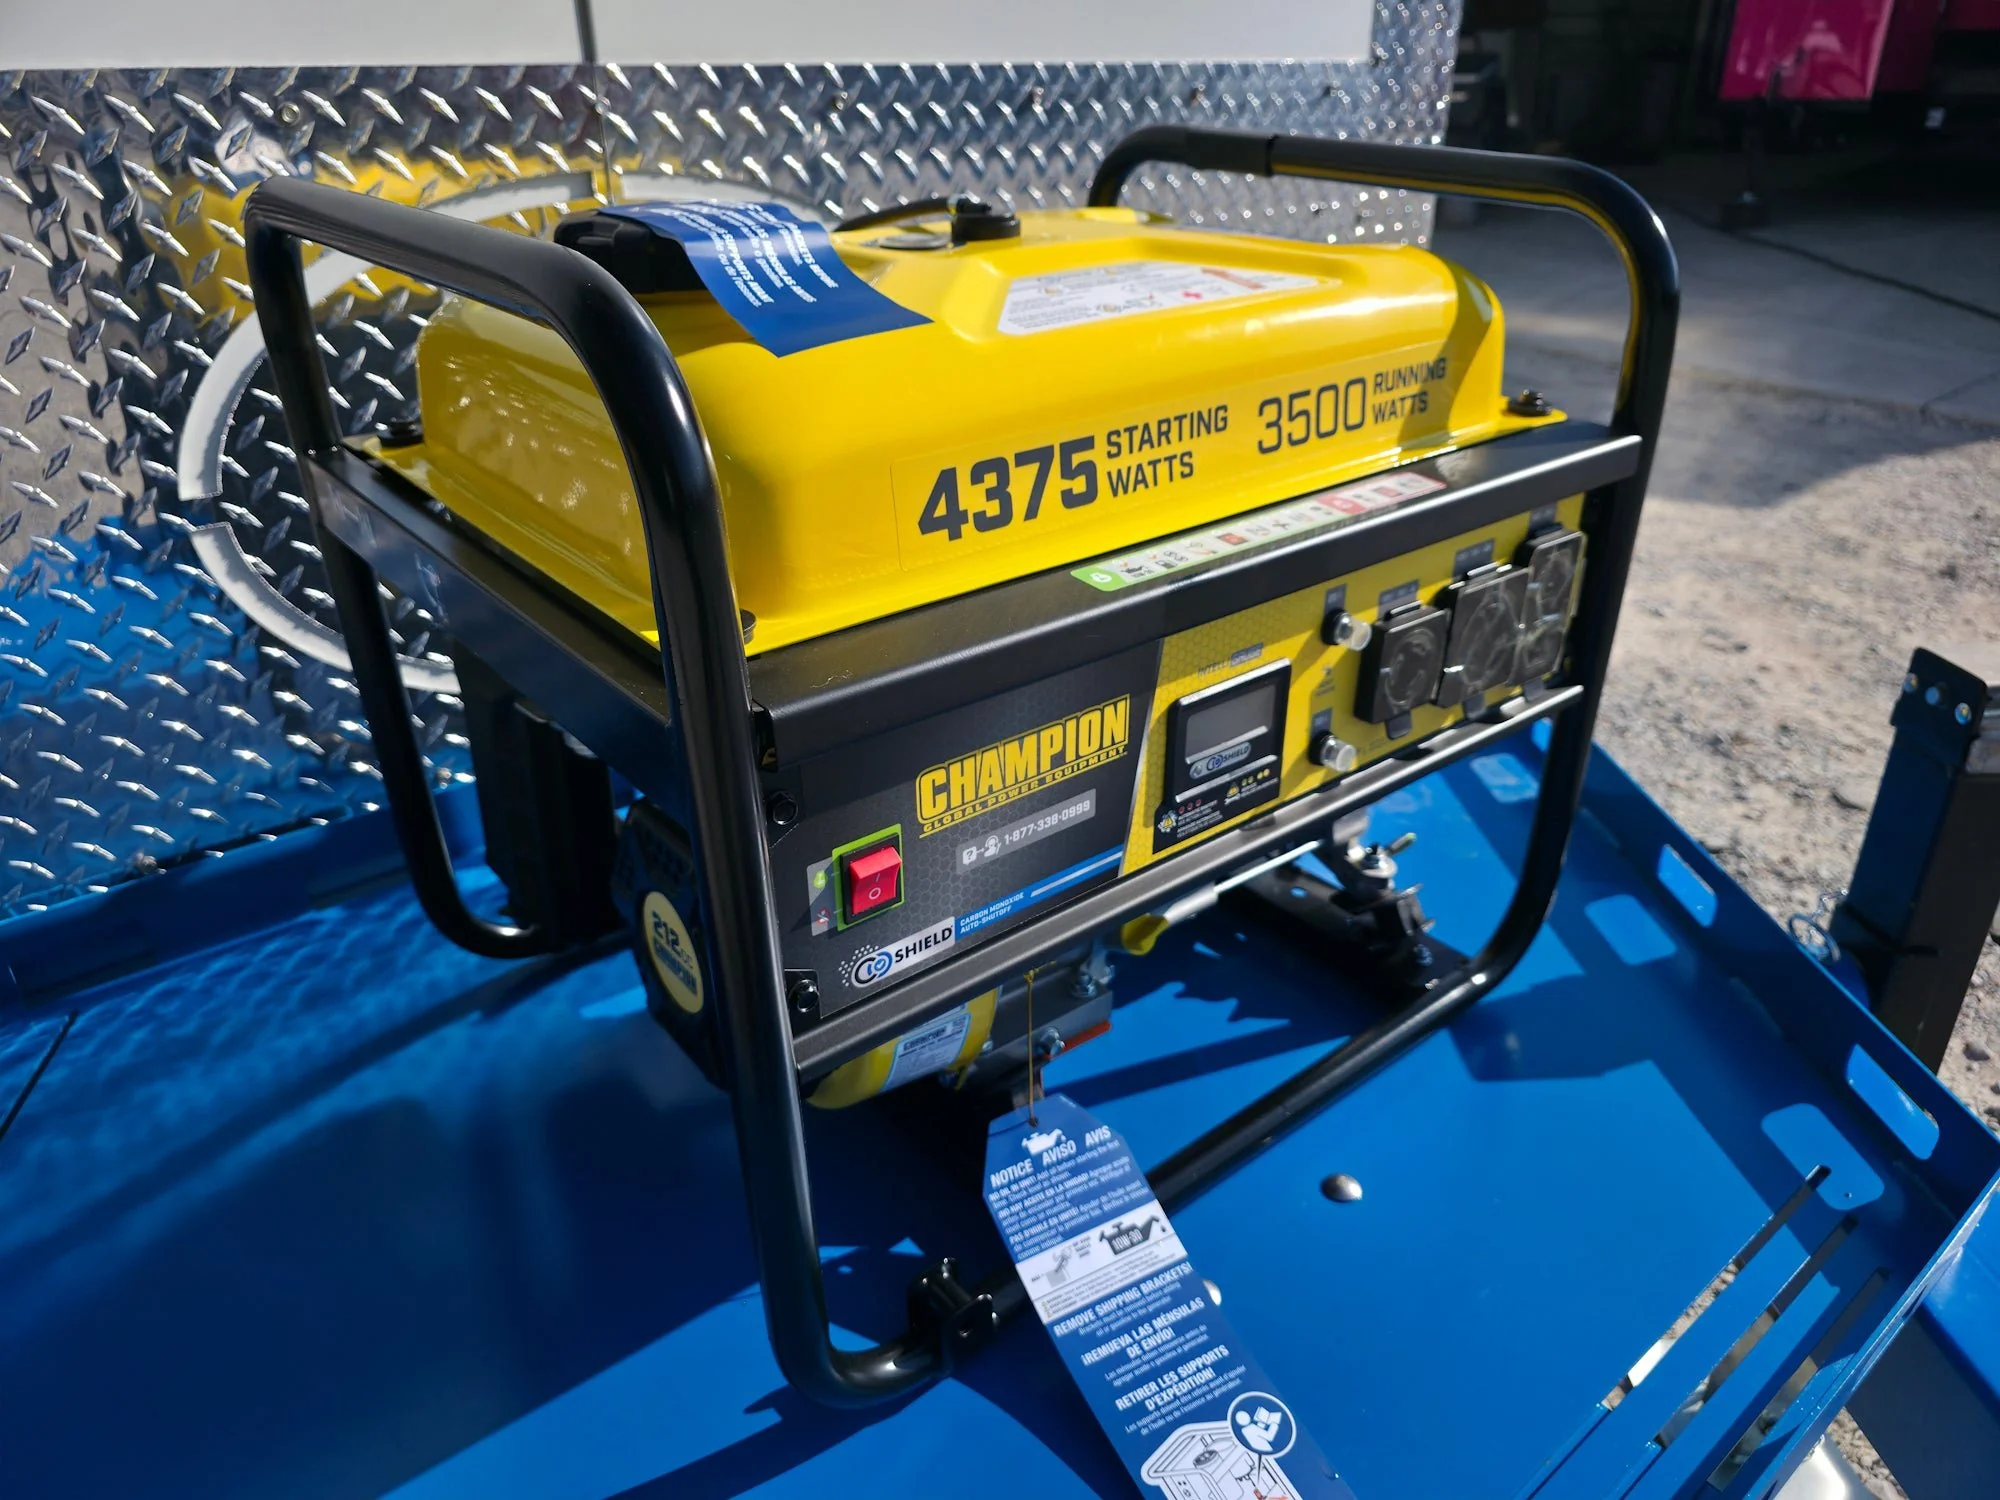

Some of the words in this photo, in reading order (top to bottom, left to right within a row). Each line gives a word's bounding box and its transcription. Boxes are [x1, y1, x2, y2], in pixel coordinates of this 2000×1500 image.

[1373, 357, 1447, 395] RUNNING
[1106, 404, 1229, 459] STARTING
[1257, 376, 1367, 454] 3500
[1372, 391, 1428, 424] WATTS
[918, 435, 1098, 541] 4375
[1107, 450, 1194, 498] WATTS
[918, 695, 1129, 822] CHAMPION
[923, 801, 983, 832] GLOBAL
[987, 778, 1039, 807] POWER
[1045, 745, 1125, 783] EQUIPMENT
[652, 910, 683, 958] 212
[960, 908, 988, 927] CARBON
[989, 892, 1024, 913] MONOXIDE
[960, 905, 1012, 934] AUTO-SHUTOFF
[895, 926, 953, 963] SHIELD
[990, 1158, 1034, 1188] NOTICE
[1042, 1140, 1077, 1166] AVISO
[1084, 1125, 1112, 1147] AVIS
[1053, 1309, 1097, 1337] REMOVE
[1095, 1287, 1142, 1317] SHIPPING
[1140, 1262, 1194, 1294] BRACKETS!
[1081, 1334, 1134, 1366] ¡REMUEVA
[1131, 1322, 1154, 1343] LAS
[1153, 1297, 1206, 1330] MÉNSULAS
[1126, 1343, 1143, 1359] DE
[1141, 1327, 1176, 1349] ENVÍO!
[1115, 1381, 1160, 1411] RETIRER
[1158, 1371, 1180, 1391] LES
[1177, 1345, 1230, 1378] SUPPORTS
[1145, 1367, 1216, 1411] D'EXPÉDITION!
